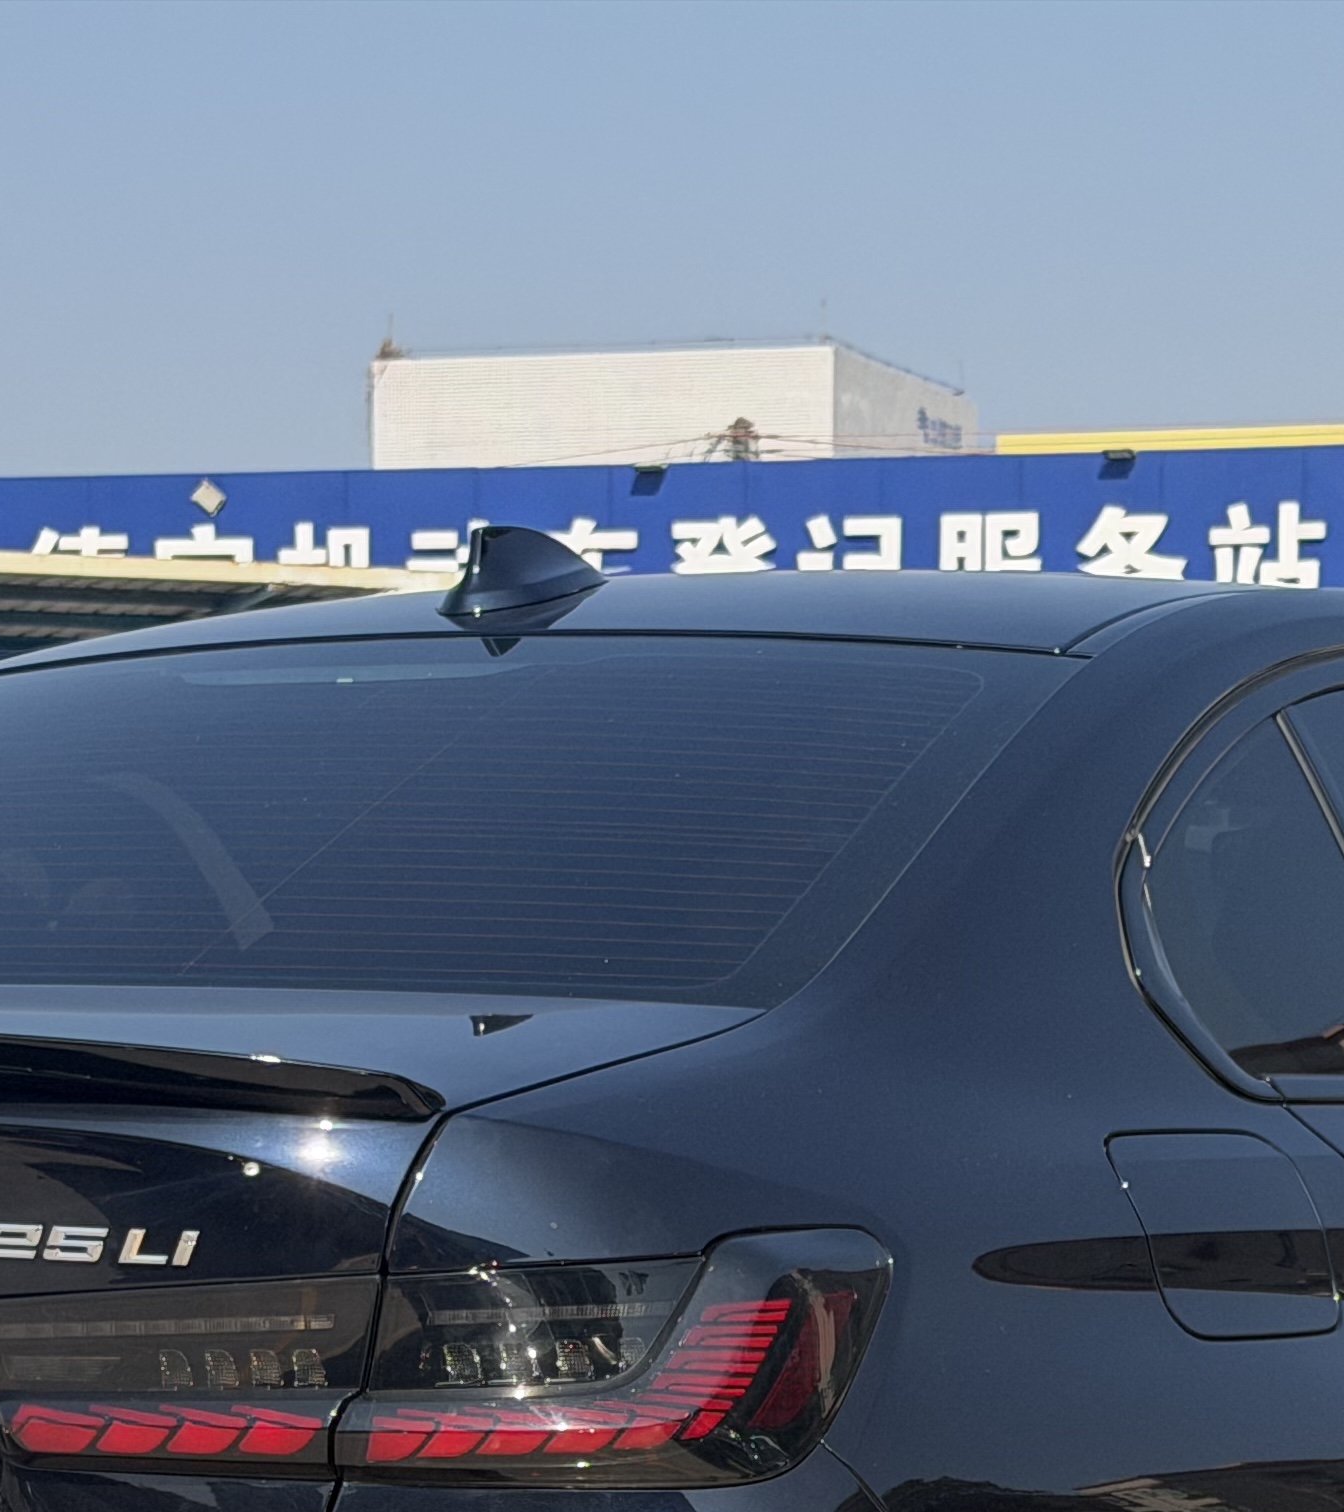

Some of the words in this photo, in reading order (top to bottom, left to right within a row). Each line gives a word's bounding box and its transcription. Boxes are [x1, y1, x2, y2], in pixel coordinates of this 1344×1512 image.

[31, 501, 1328, 590] 登记服务站
